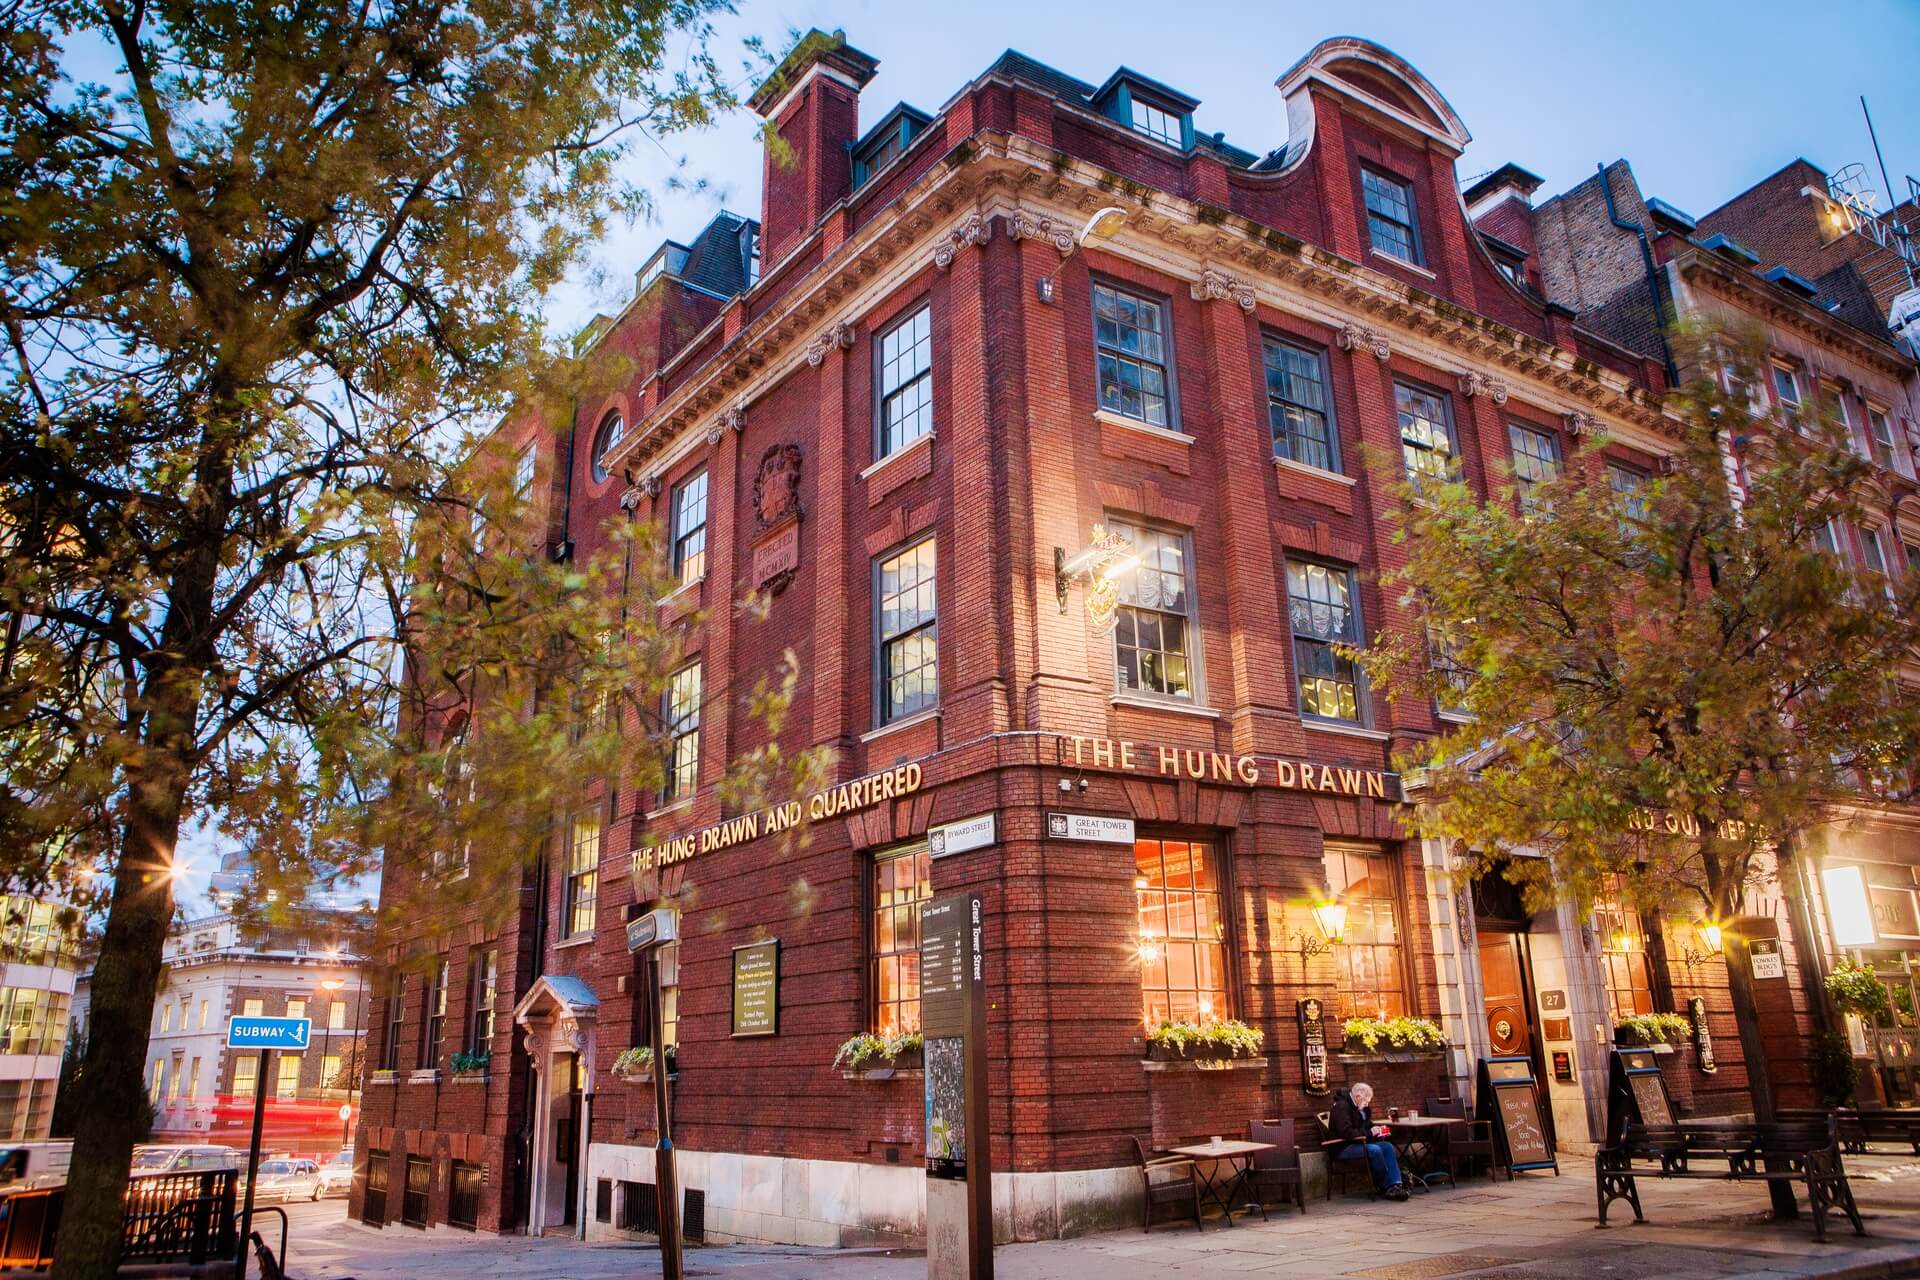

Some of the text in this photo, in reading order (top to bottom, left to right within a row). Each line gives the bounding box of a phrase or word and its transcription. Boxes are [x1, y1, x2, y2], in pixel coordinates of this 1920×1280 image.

[1072, 736, 1136, 770] THE
[1159, 746, 1259, 784] HUNG
[1278, 761, 1385, 798] DRAWN
[631, 763, 922, 872] THE HUNG DRAWN AND QUARTERED
[971, 821, 990, 833] STREET
[1076, 818, 1128, 830] GREAT TOWER
[1076, 828, 1101, 837] STREET
[971, 900, 982, 981] Great Tower Street
[1546, 994, 1559, 1006] 27
[234, 1026, 285, 1037] SUBWAY
